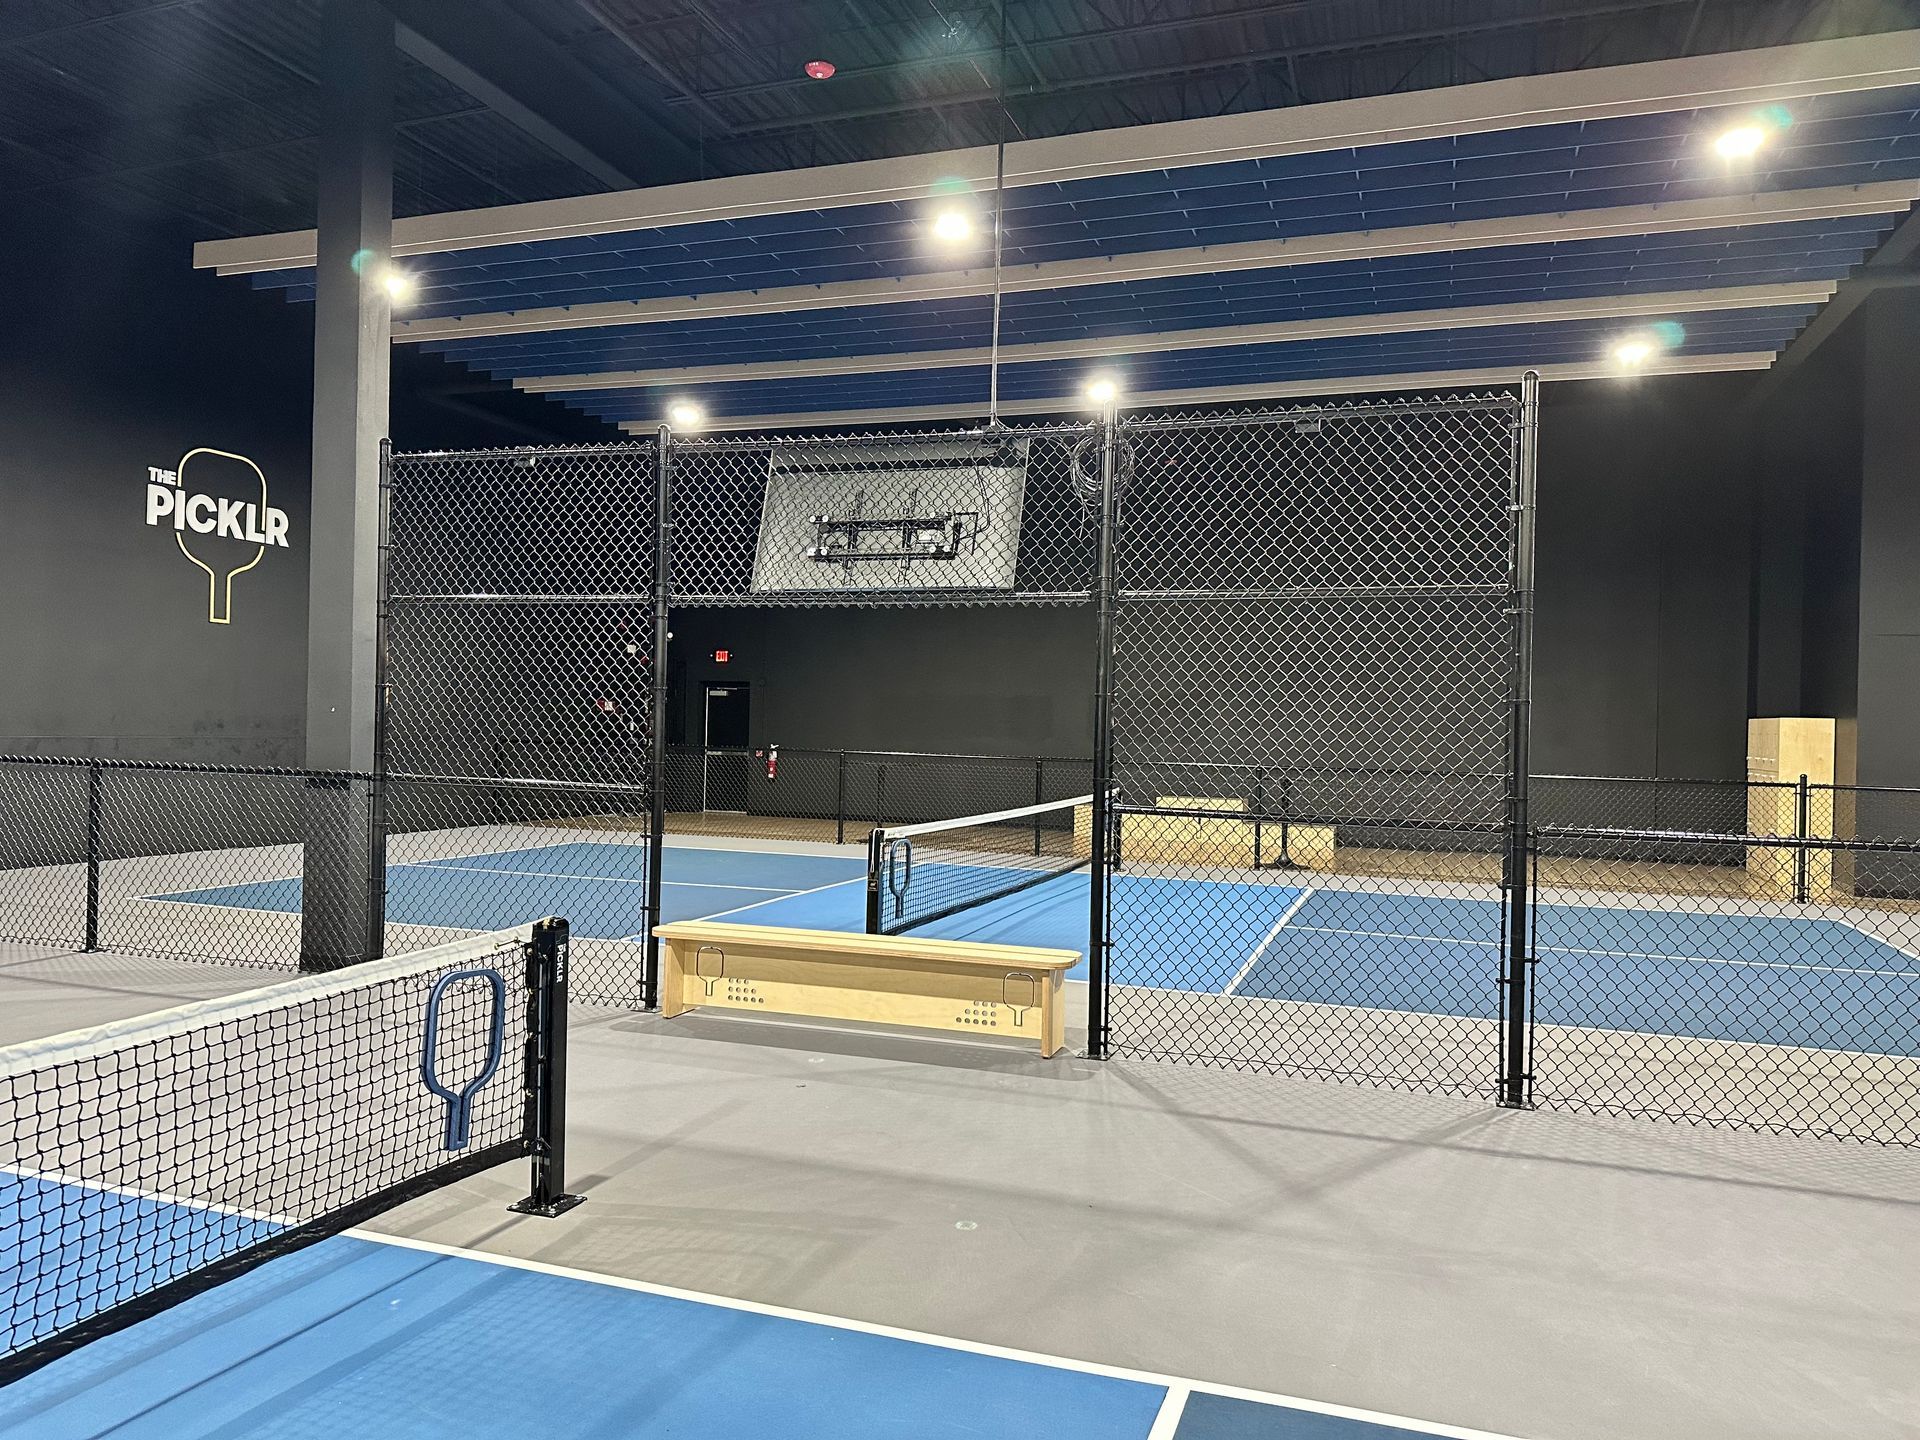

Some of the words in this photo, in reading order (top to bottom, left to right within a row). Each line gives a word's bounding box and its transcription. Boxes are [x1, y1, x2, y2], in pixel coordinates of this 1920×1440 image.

[147, 467, 177, 486] THE
[146, 483, 290, 548] PICKLR
[556, 944, 564, 983] PICKLR
